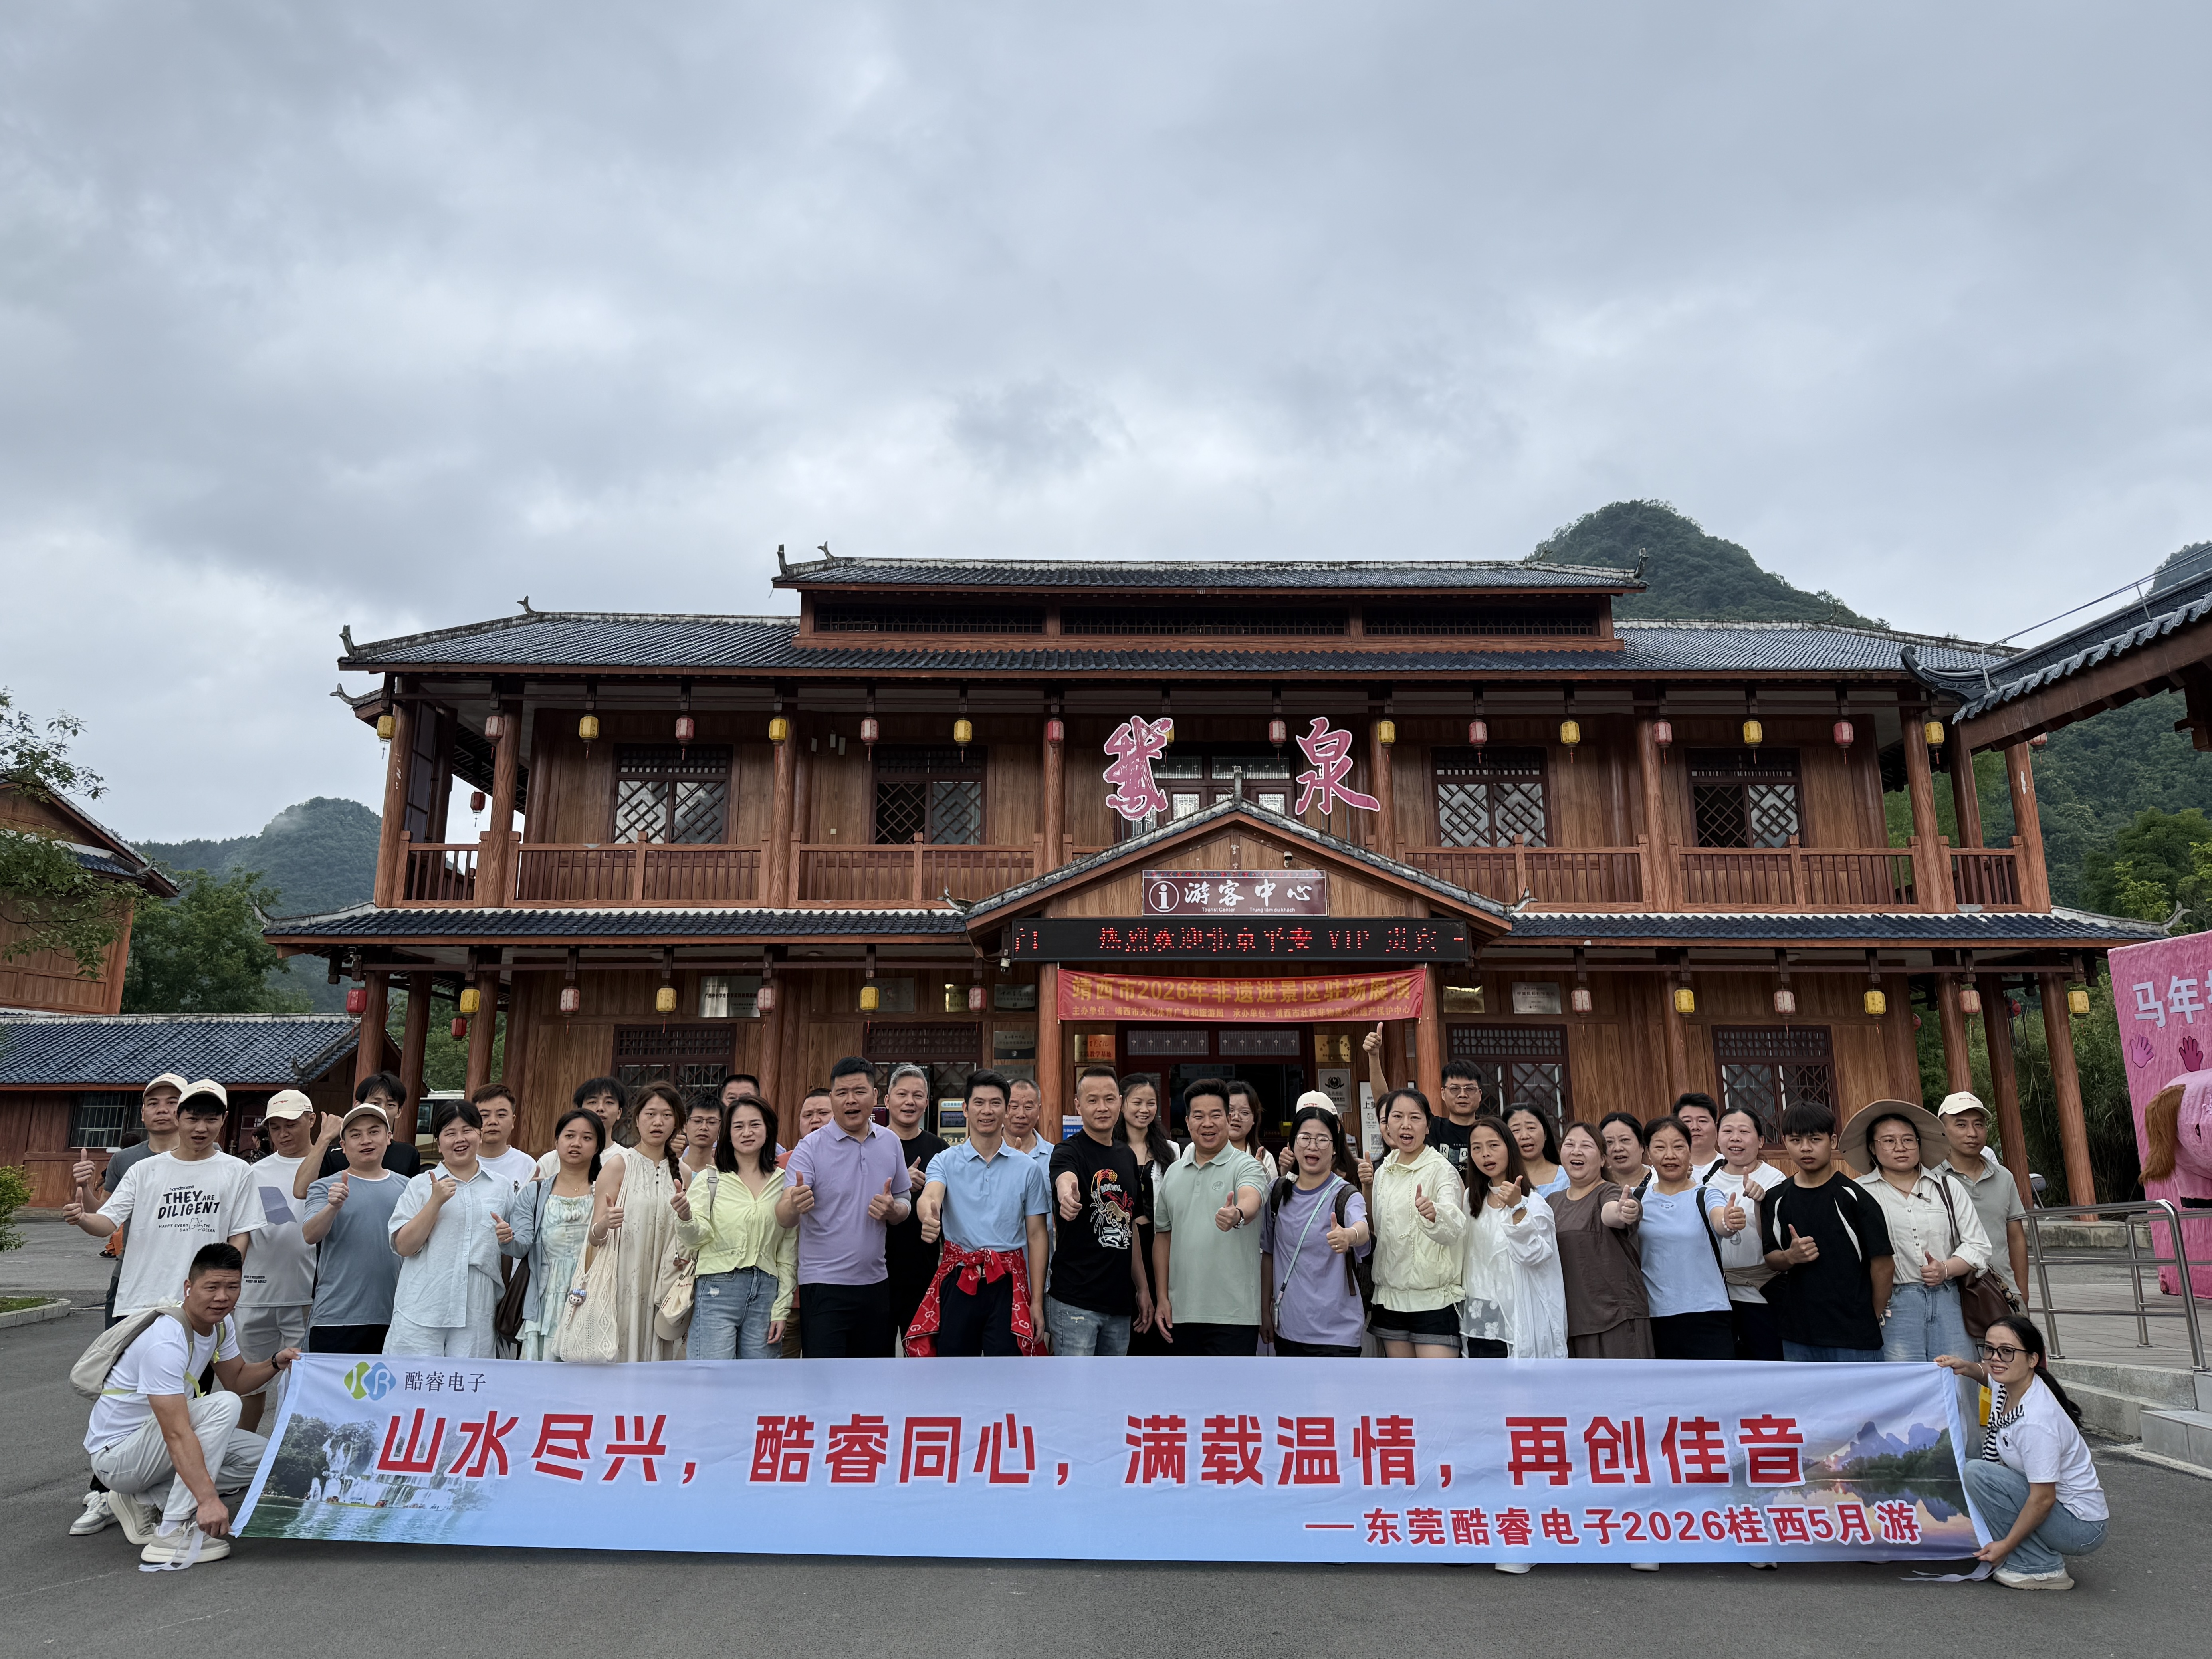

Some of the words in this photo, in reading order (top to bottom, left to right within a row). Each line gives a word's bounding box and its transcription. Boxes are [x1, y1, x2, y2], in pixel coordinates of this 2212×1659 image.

[1184, 878, 1312, 907] 游客中心
[1329, 931, 1369, 949] VIP
[1072, 976, 1411, 1003] 靖西市2026年非遗进景区驻场展演
[2131, 969, 2212, 1028] 马年
[163, 1190, 203, 1204] THEY
[157, 1201, 220, 1219] DILIGENT
[404, 1370, 486, 1393] 酷睿电子
